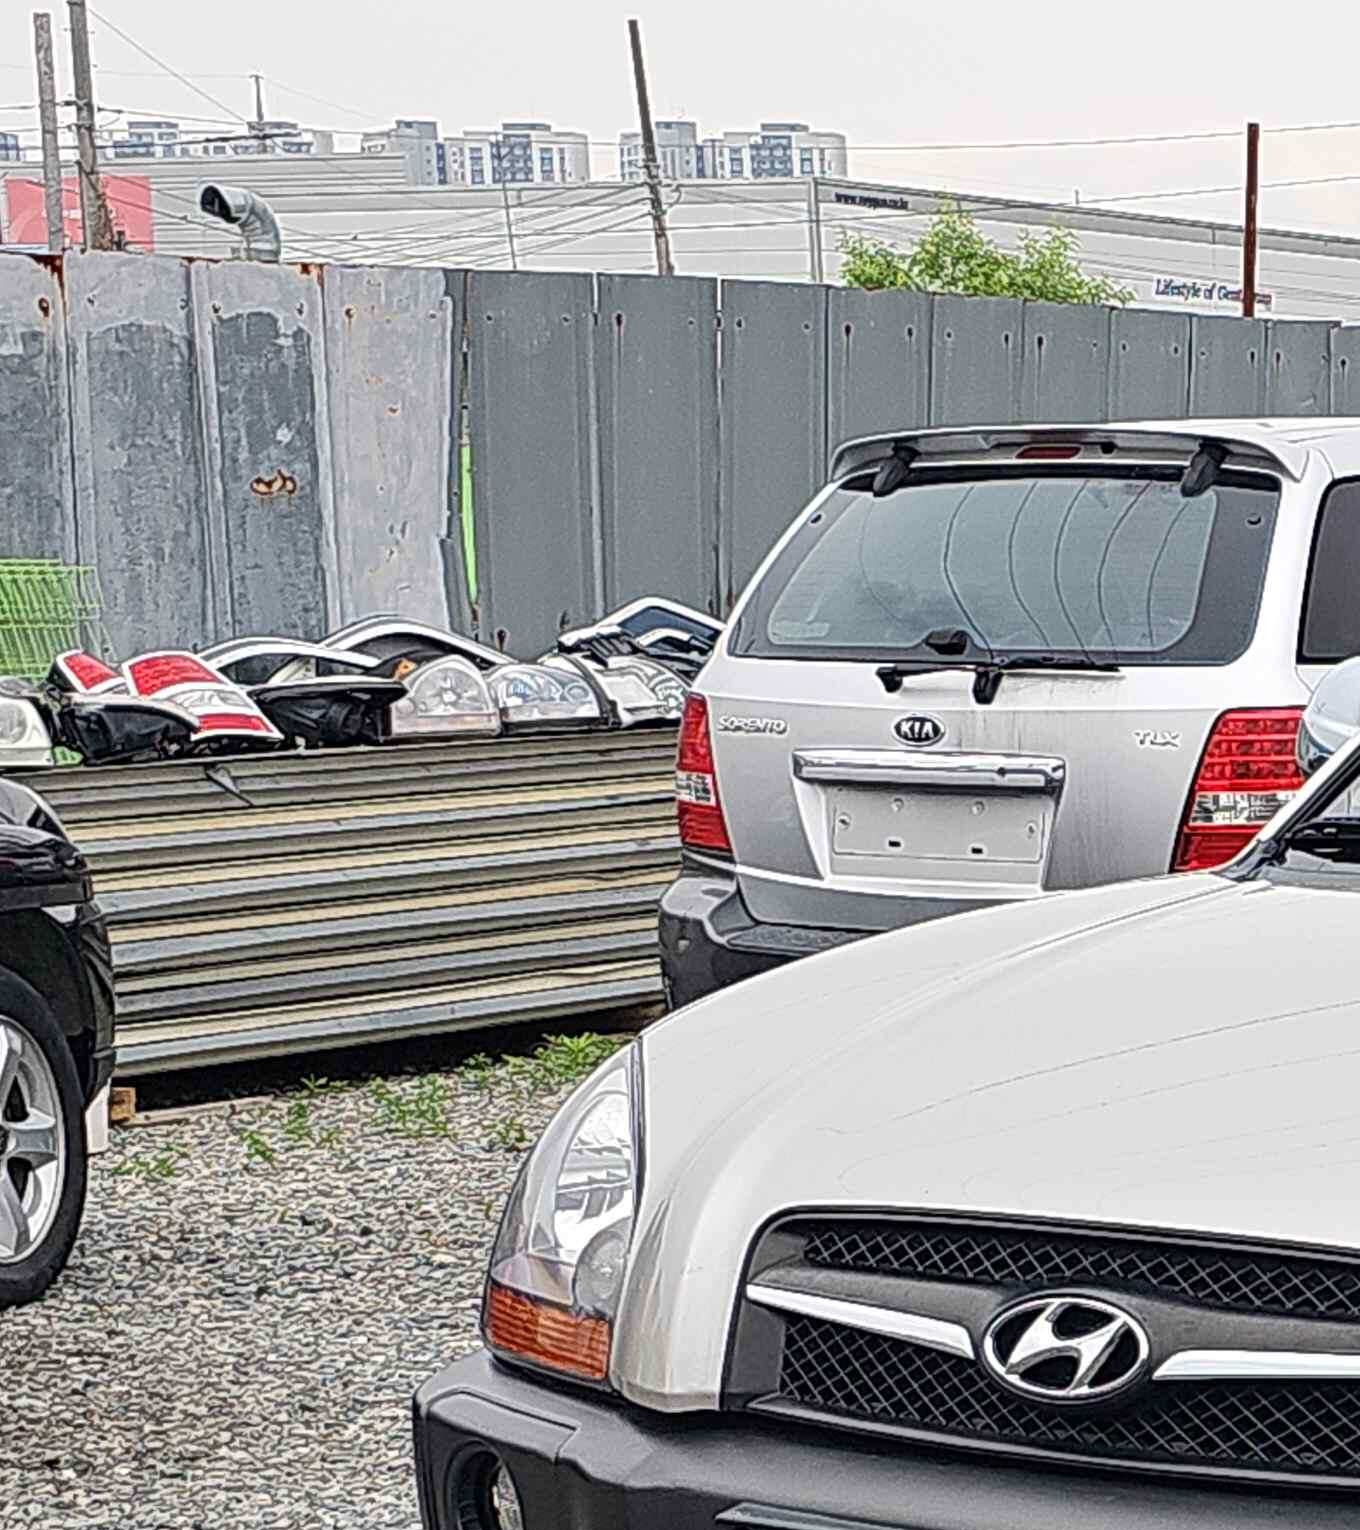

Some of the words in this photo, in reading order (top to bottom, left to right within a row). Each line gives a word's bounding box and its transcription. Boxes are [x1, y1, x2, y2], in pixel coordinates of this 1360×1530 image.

[1203, 282, 1216, 300] of
[717, 716, 790, 735] SORENTO
[900, 720, 935, 739] KIA
